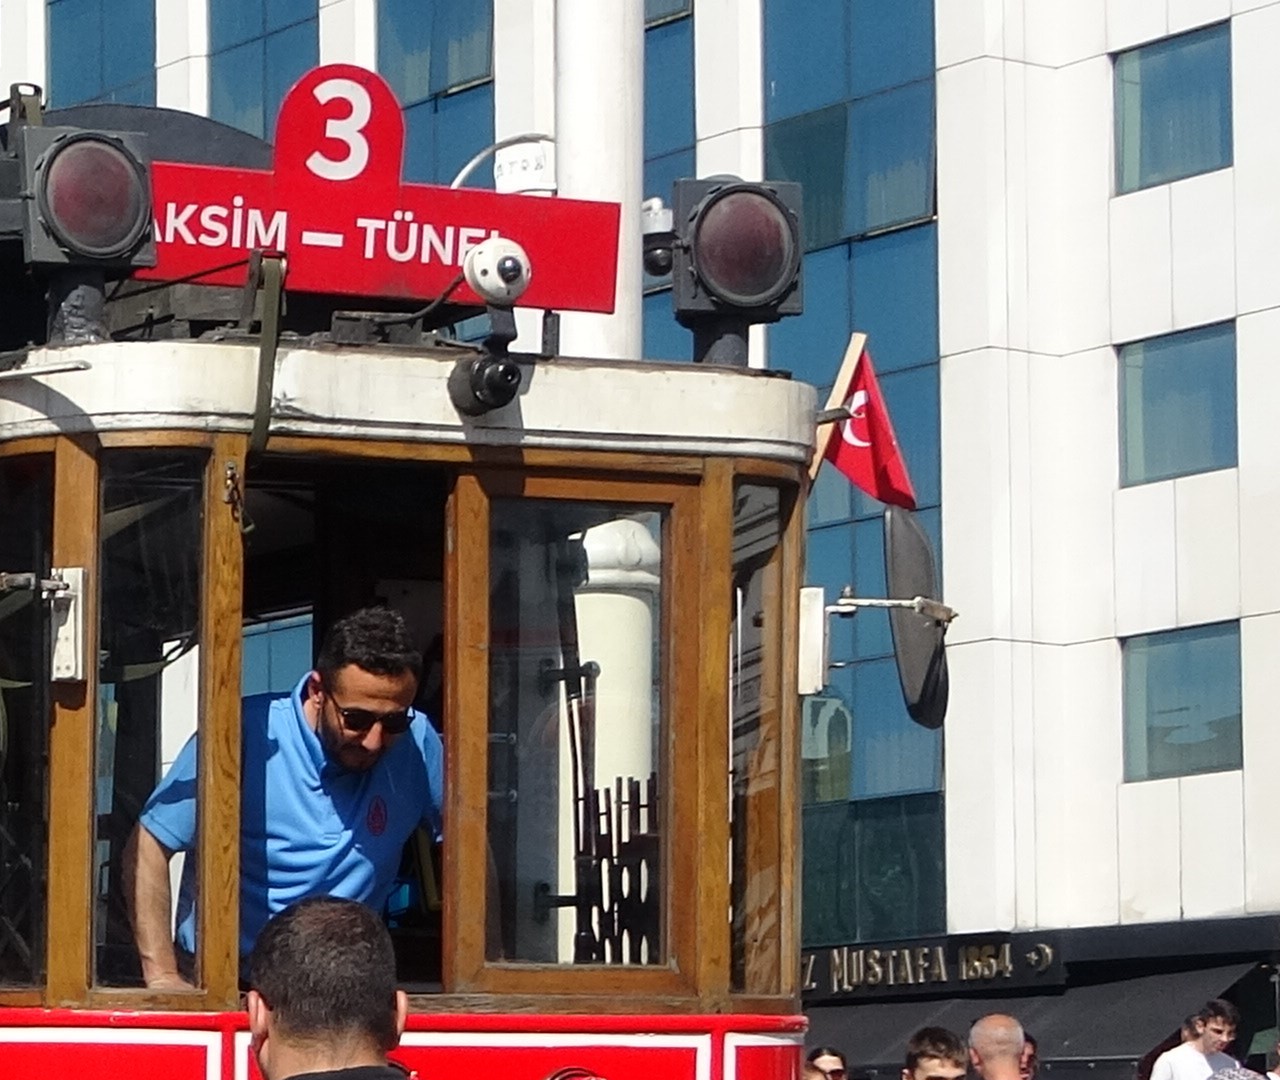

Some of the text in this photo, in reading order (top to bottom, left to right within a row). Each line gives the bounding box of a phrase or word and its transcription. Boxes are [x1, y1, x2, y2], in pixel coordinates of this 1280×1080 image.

[305, 78, 372, 180] 3
[154, 195, 288, 251] KSİM
[830, 945, 948, 994] MUSTAFA
